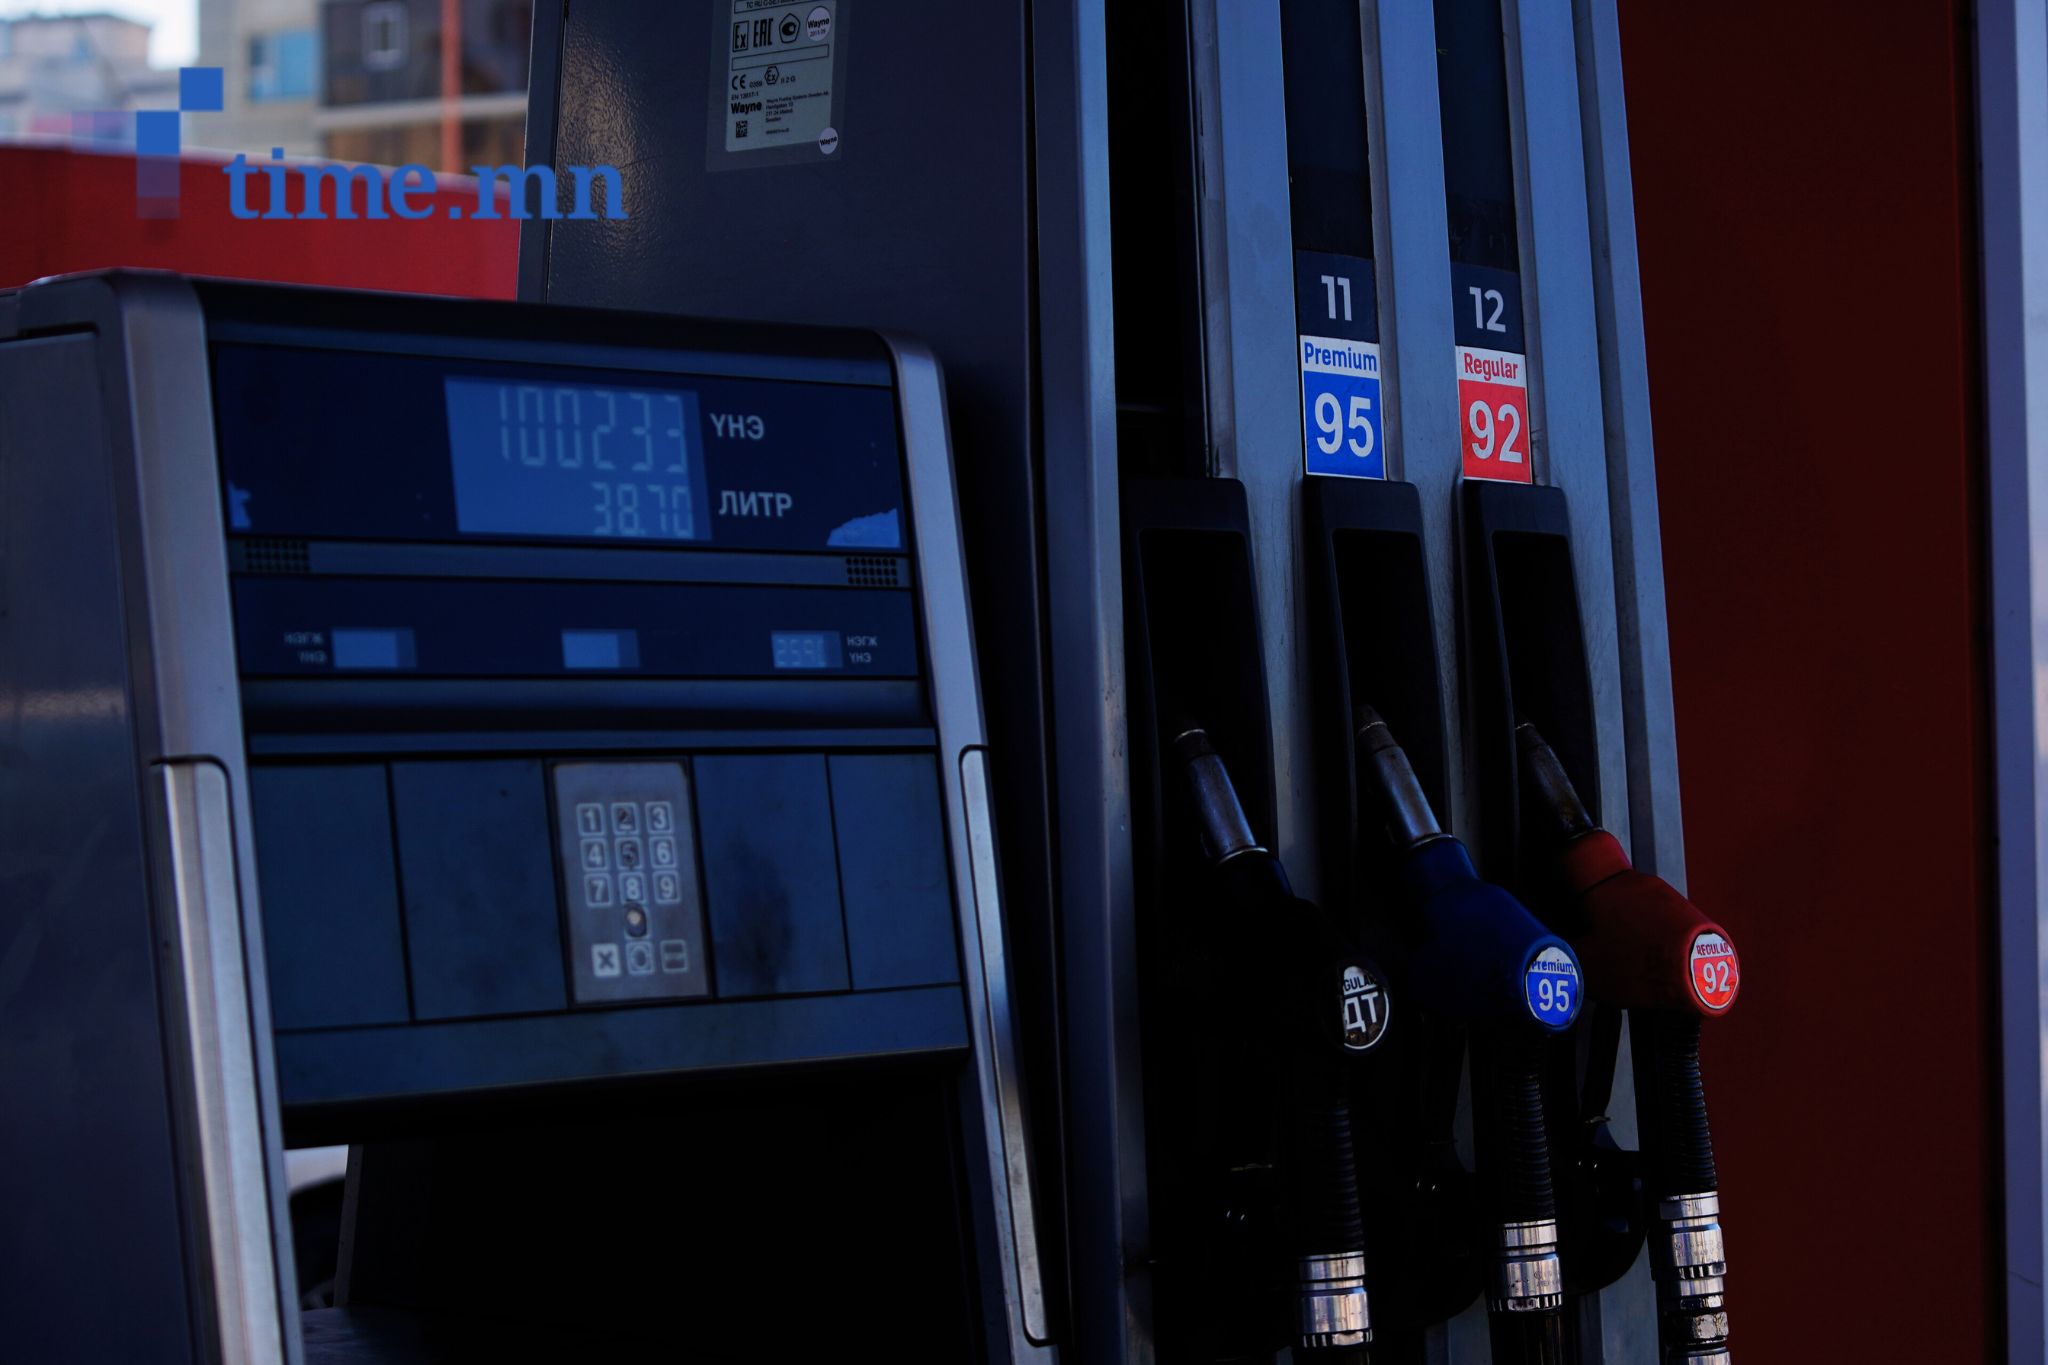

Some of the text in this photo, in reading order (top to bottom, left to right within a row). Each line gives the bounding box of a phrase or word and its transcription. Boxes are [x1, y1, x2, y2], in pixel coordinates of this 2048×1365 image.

[735, 24, 746, 49] Ex
[808, 17, 830, 29] Wayne
[730, 101, 762, 115] Wayne
[820, 137, 837, 146] Wayne
[1320, 275, 1352, 322] 11
[1469, 286, 1506, 333] 12
[1304, 342, 1377, 372] Premium
[1463, 352, 1518, 381] Regular
[1314, 392, 1375, 458] 95
[1468, 400, 1522, 464] 92
[718, 490, 793, 518] ЛИТР
[585, 806, 666, 831] 1 2 3
[588, 842, 602, 865] 4
[656, 841, 671, 861] 6
[591, 876, 674, 901] 7 8 9
[1696, 942, 1729, 956] REGULAR
[1531, 959, 1574, 974] Premium
[1702, 961, 1731, 995] 92
[1538, 977, 1570, 1012] 95
[1344, 991, 1379, 1033] ДТ
